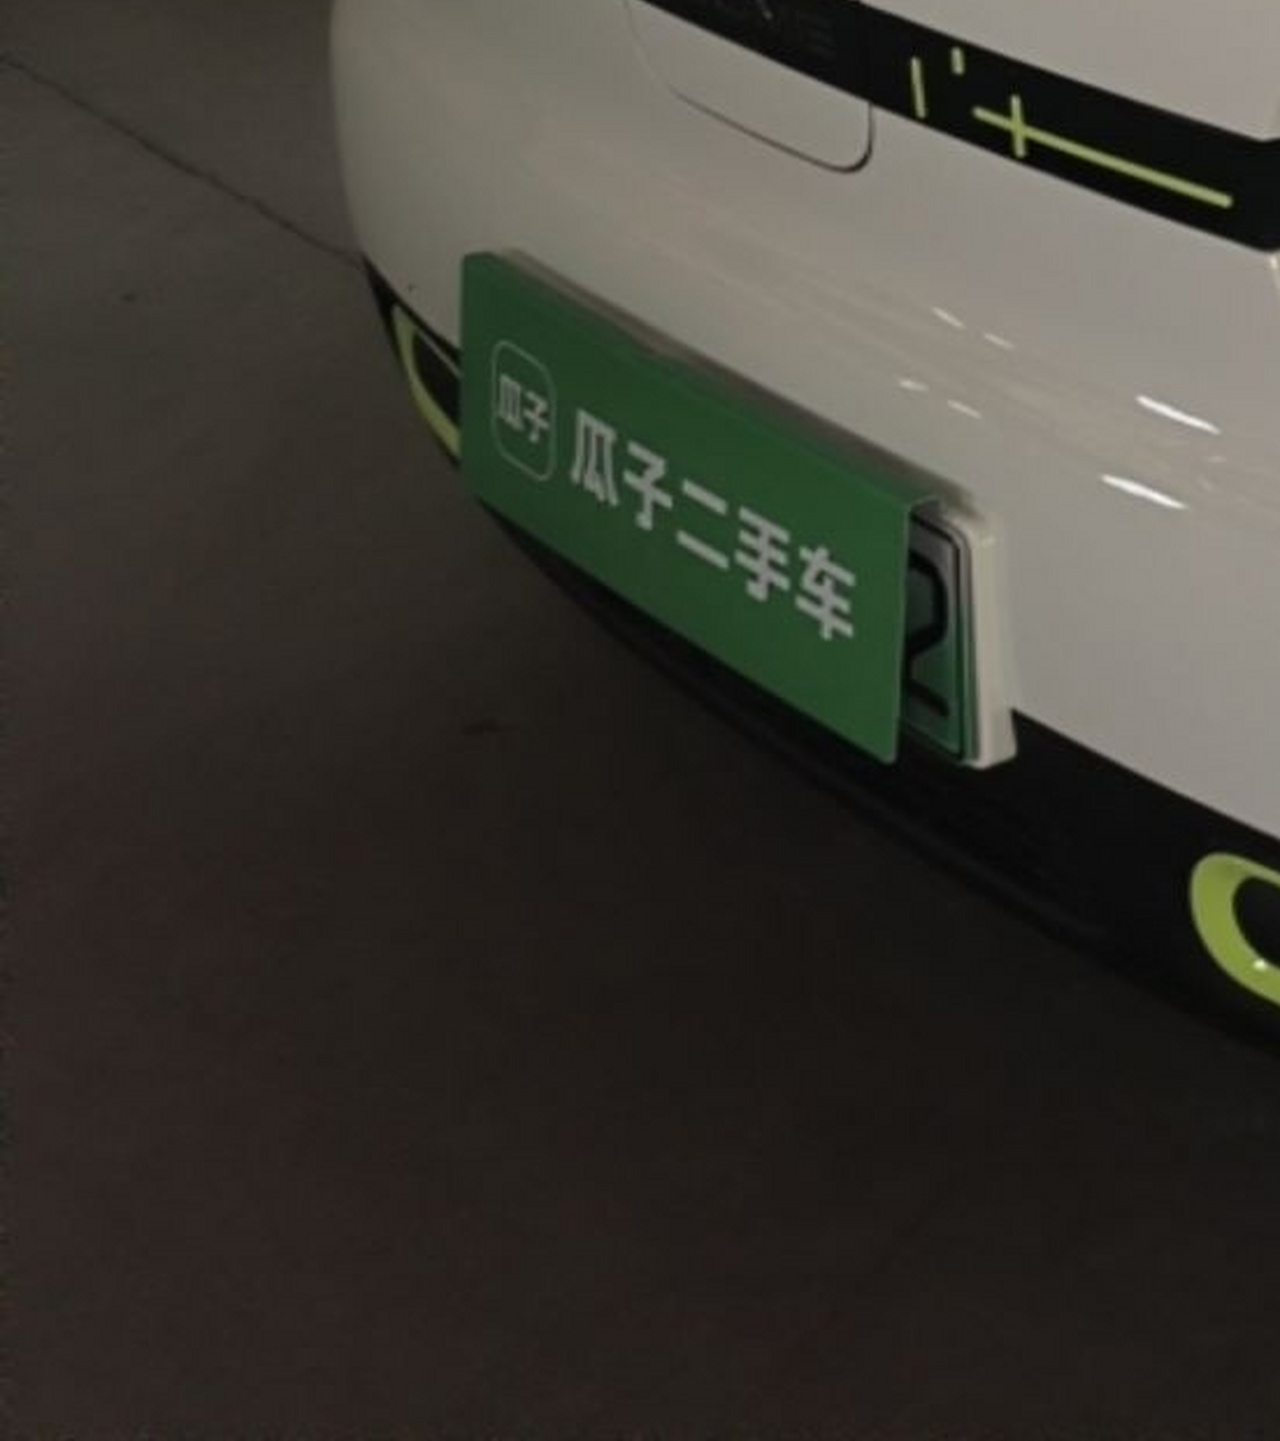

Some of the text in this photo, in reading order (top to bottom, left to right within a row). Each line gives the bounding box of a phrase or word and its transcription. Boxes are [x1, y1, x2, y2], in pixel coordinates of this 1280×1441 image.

[497, 374, 549, 442] 瓜子
[571, 409, 856, 641] 瓜子二手车
